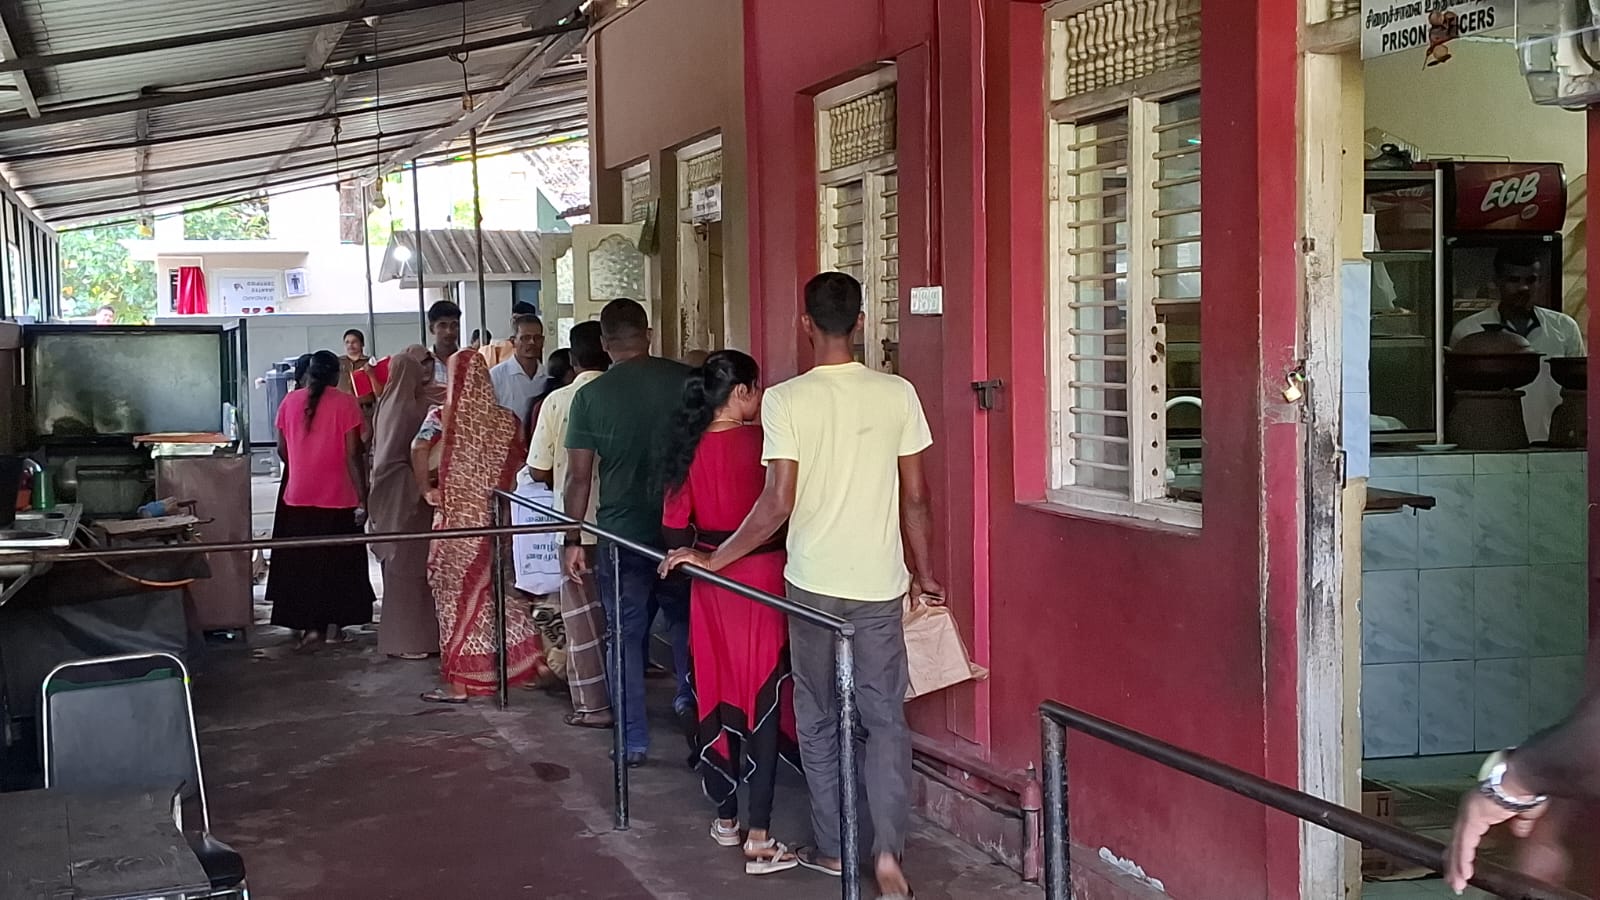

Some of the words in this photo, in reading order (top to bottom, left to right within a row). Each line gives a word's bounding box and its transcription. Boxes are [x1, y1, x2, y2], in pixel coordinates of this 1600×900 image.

[1382, 24, 1427, 52] PRISON
[1441, 6, 1495, 38] ICERS
[1480, 171, 1540, 212] EGB
